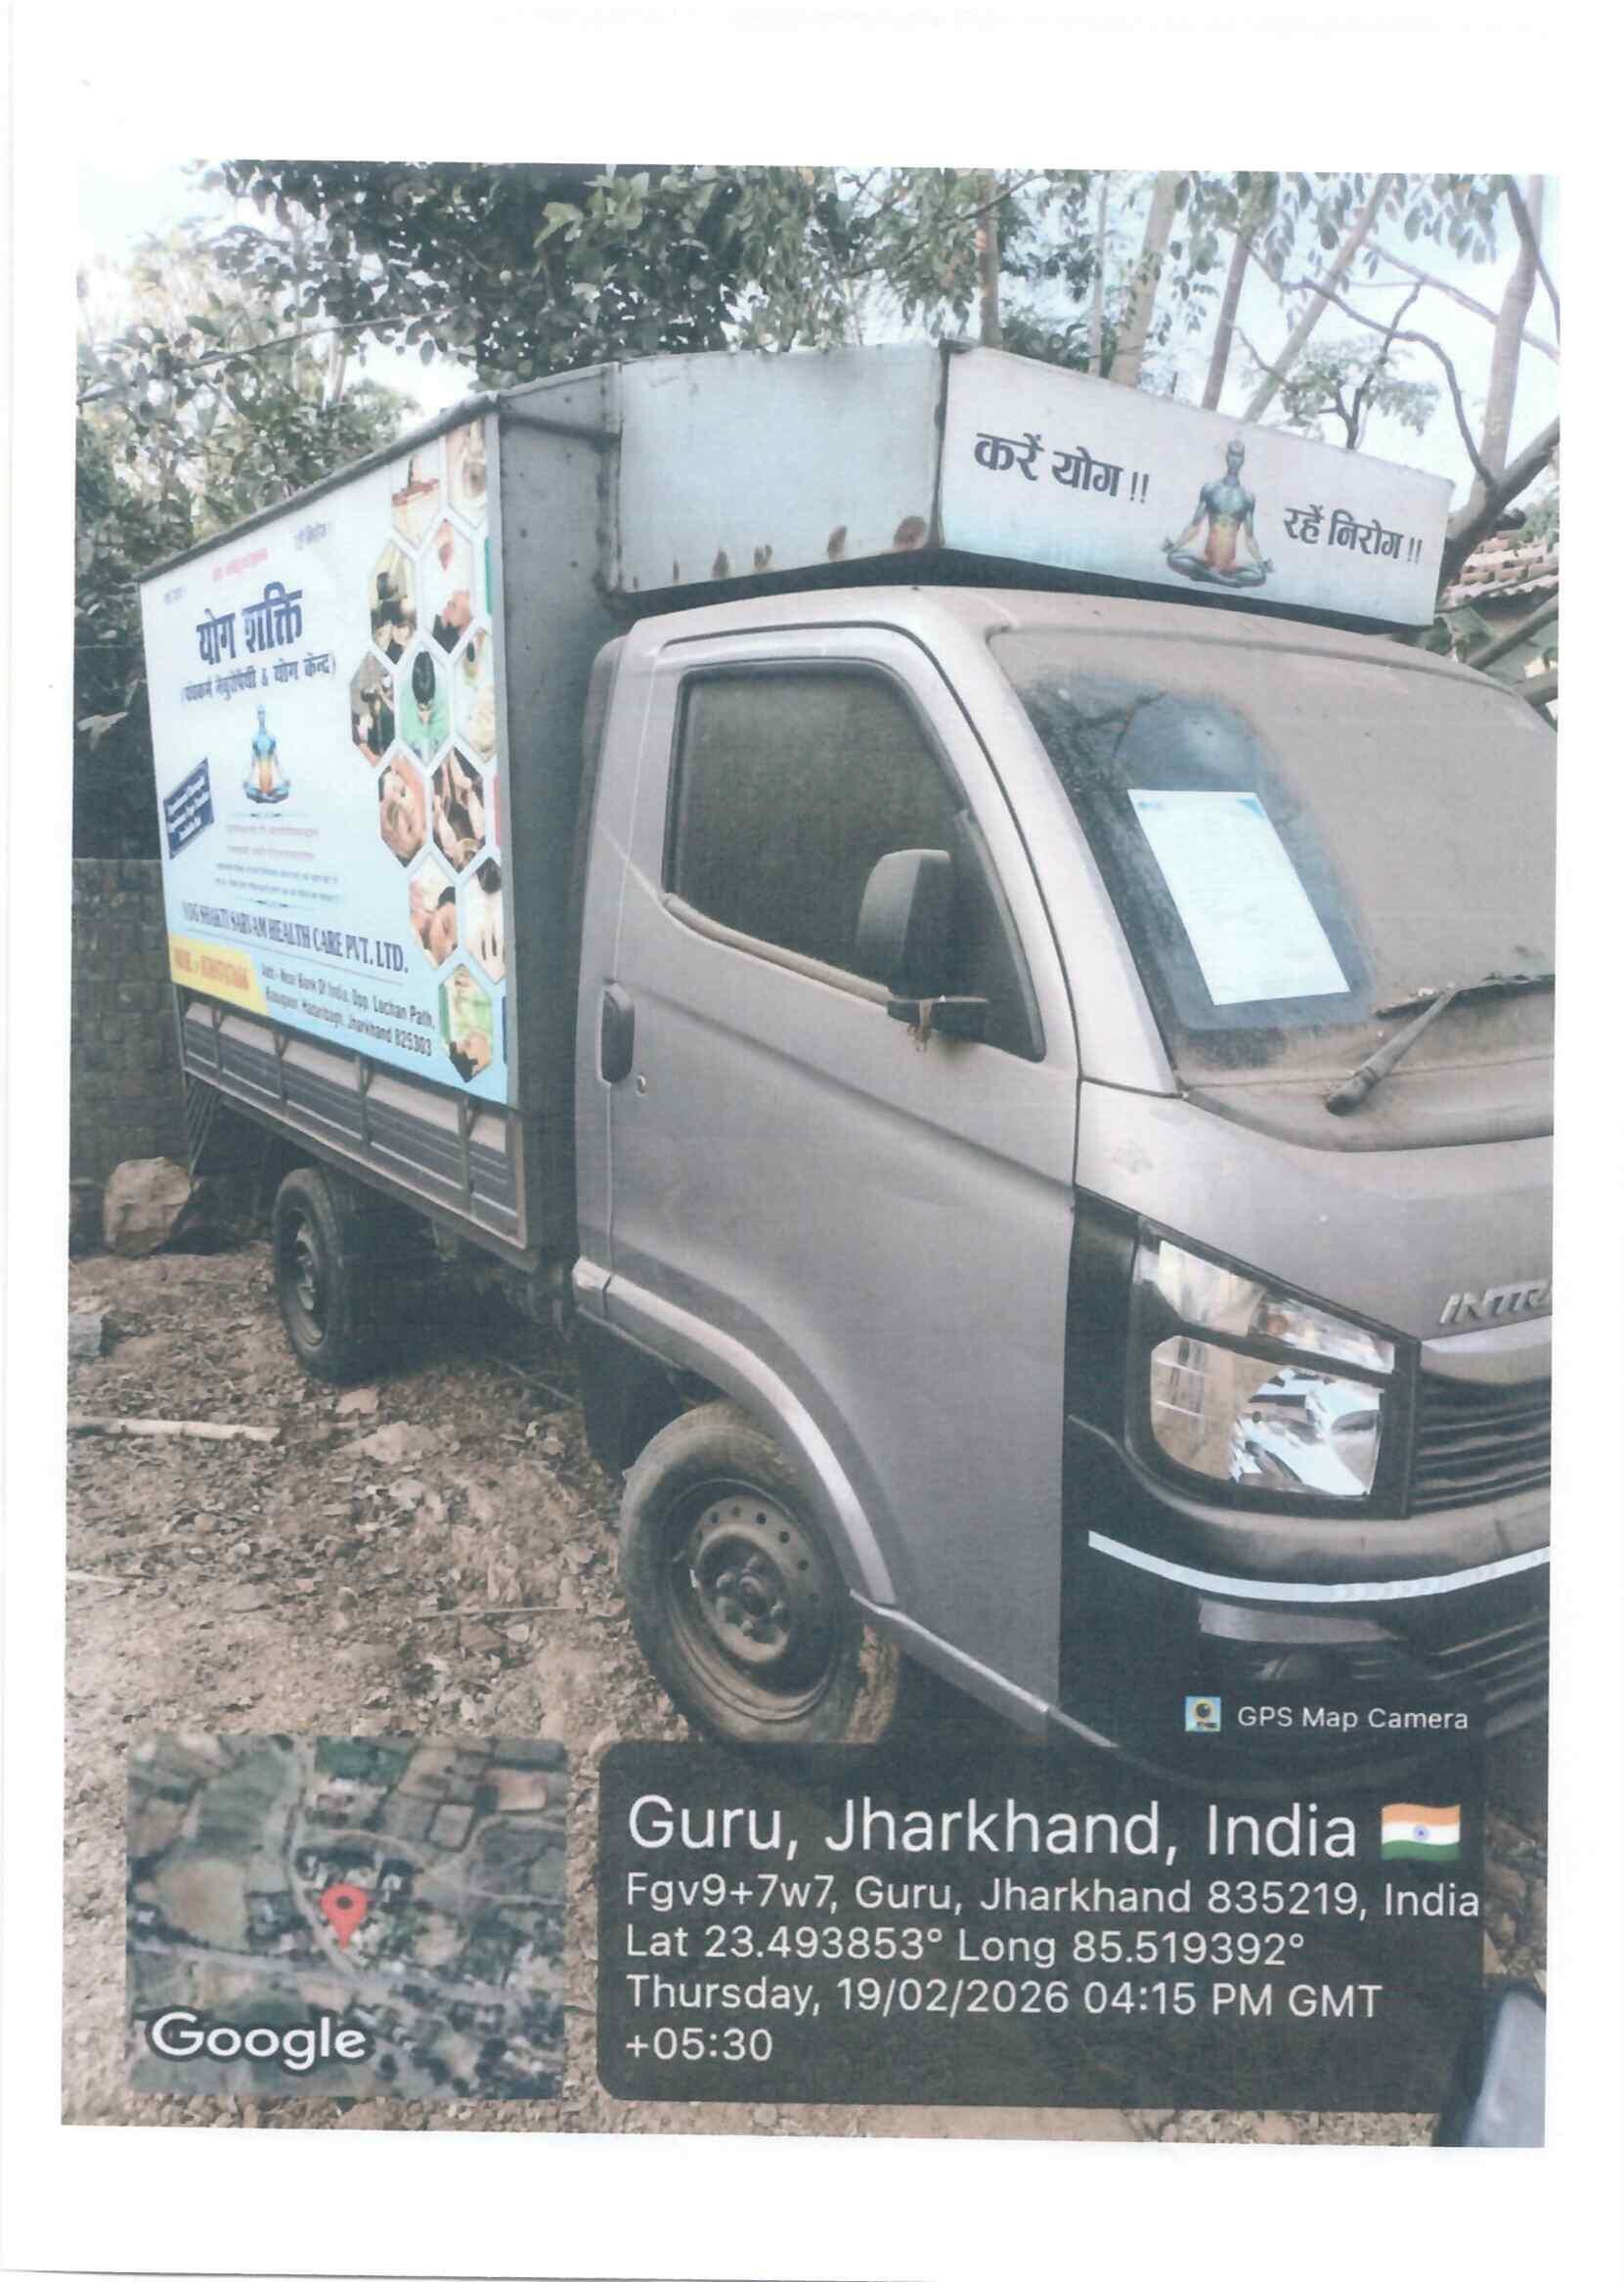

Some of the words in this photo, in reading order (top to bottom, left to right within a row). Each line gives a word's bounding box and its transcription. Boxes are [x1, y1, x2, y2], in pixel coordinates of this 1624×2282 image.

[974, 432, 1045, 481] करें
[1051, 445, 1124, 498] योग
[1283, 504, 1325, 545] रहें
[1328, 508, 1404, 559] निरोग
[196, 607, 237, 666] योग
[241, 581, 303, 654] शक्ति
[273, 657, 298, 683] योग
[268, 919, 311, 949] HEALTH
[313, 927, 344, 957] CARE
[345, 934, 373, 966] PVT.
[375, 941, 409, 974] LTD.
[1437, 1280, 1552, 1324] INTR
